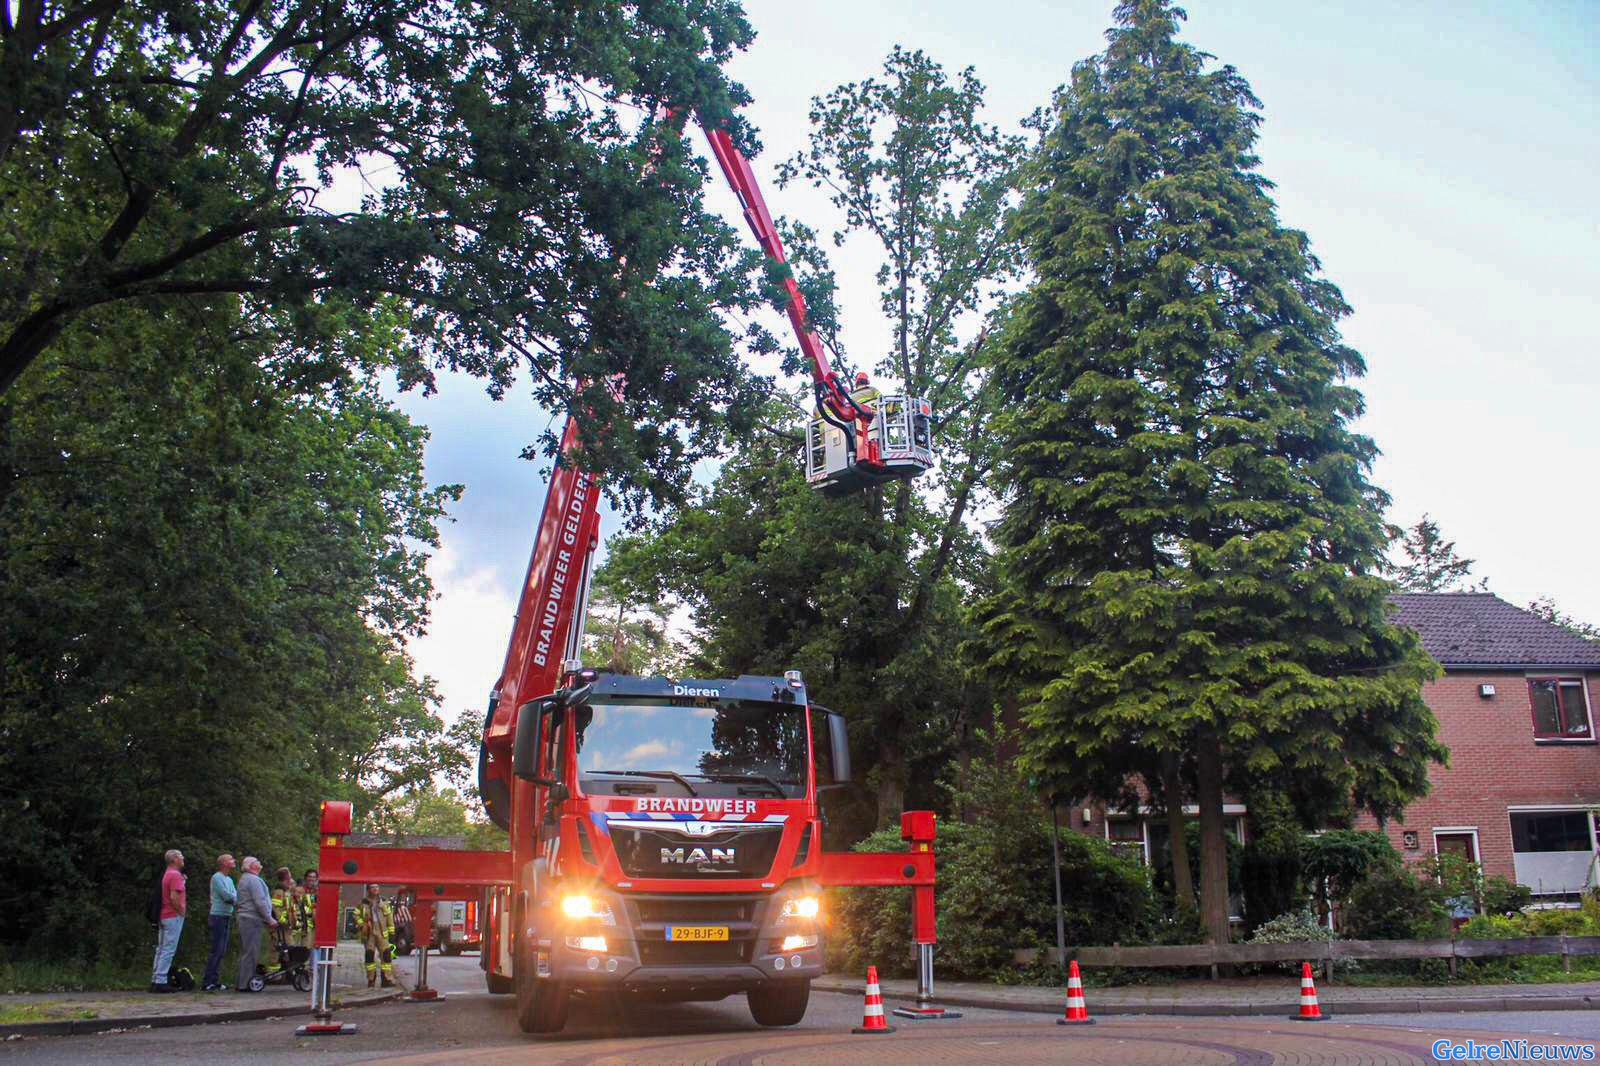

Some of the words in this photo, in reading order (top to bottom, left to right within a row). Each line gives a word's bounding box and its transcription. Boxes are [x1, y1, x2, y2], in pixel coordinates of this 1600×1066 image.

[534, 550, 571, 667] BRANDWEER
[673, 685, 720, 697] Dieren
[637, 798, 757, 813] BRANDWEER
[660, 847, 735, 864] MAN
[676, 928, 724, 939] 29-BJF-9
